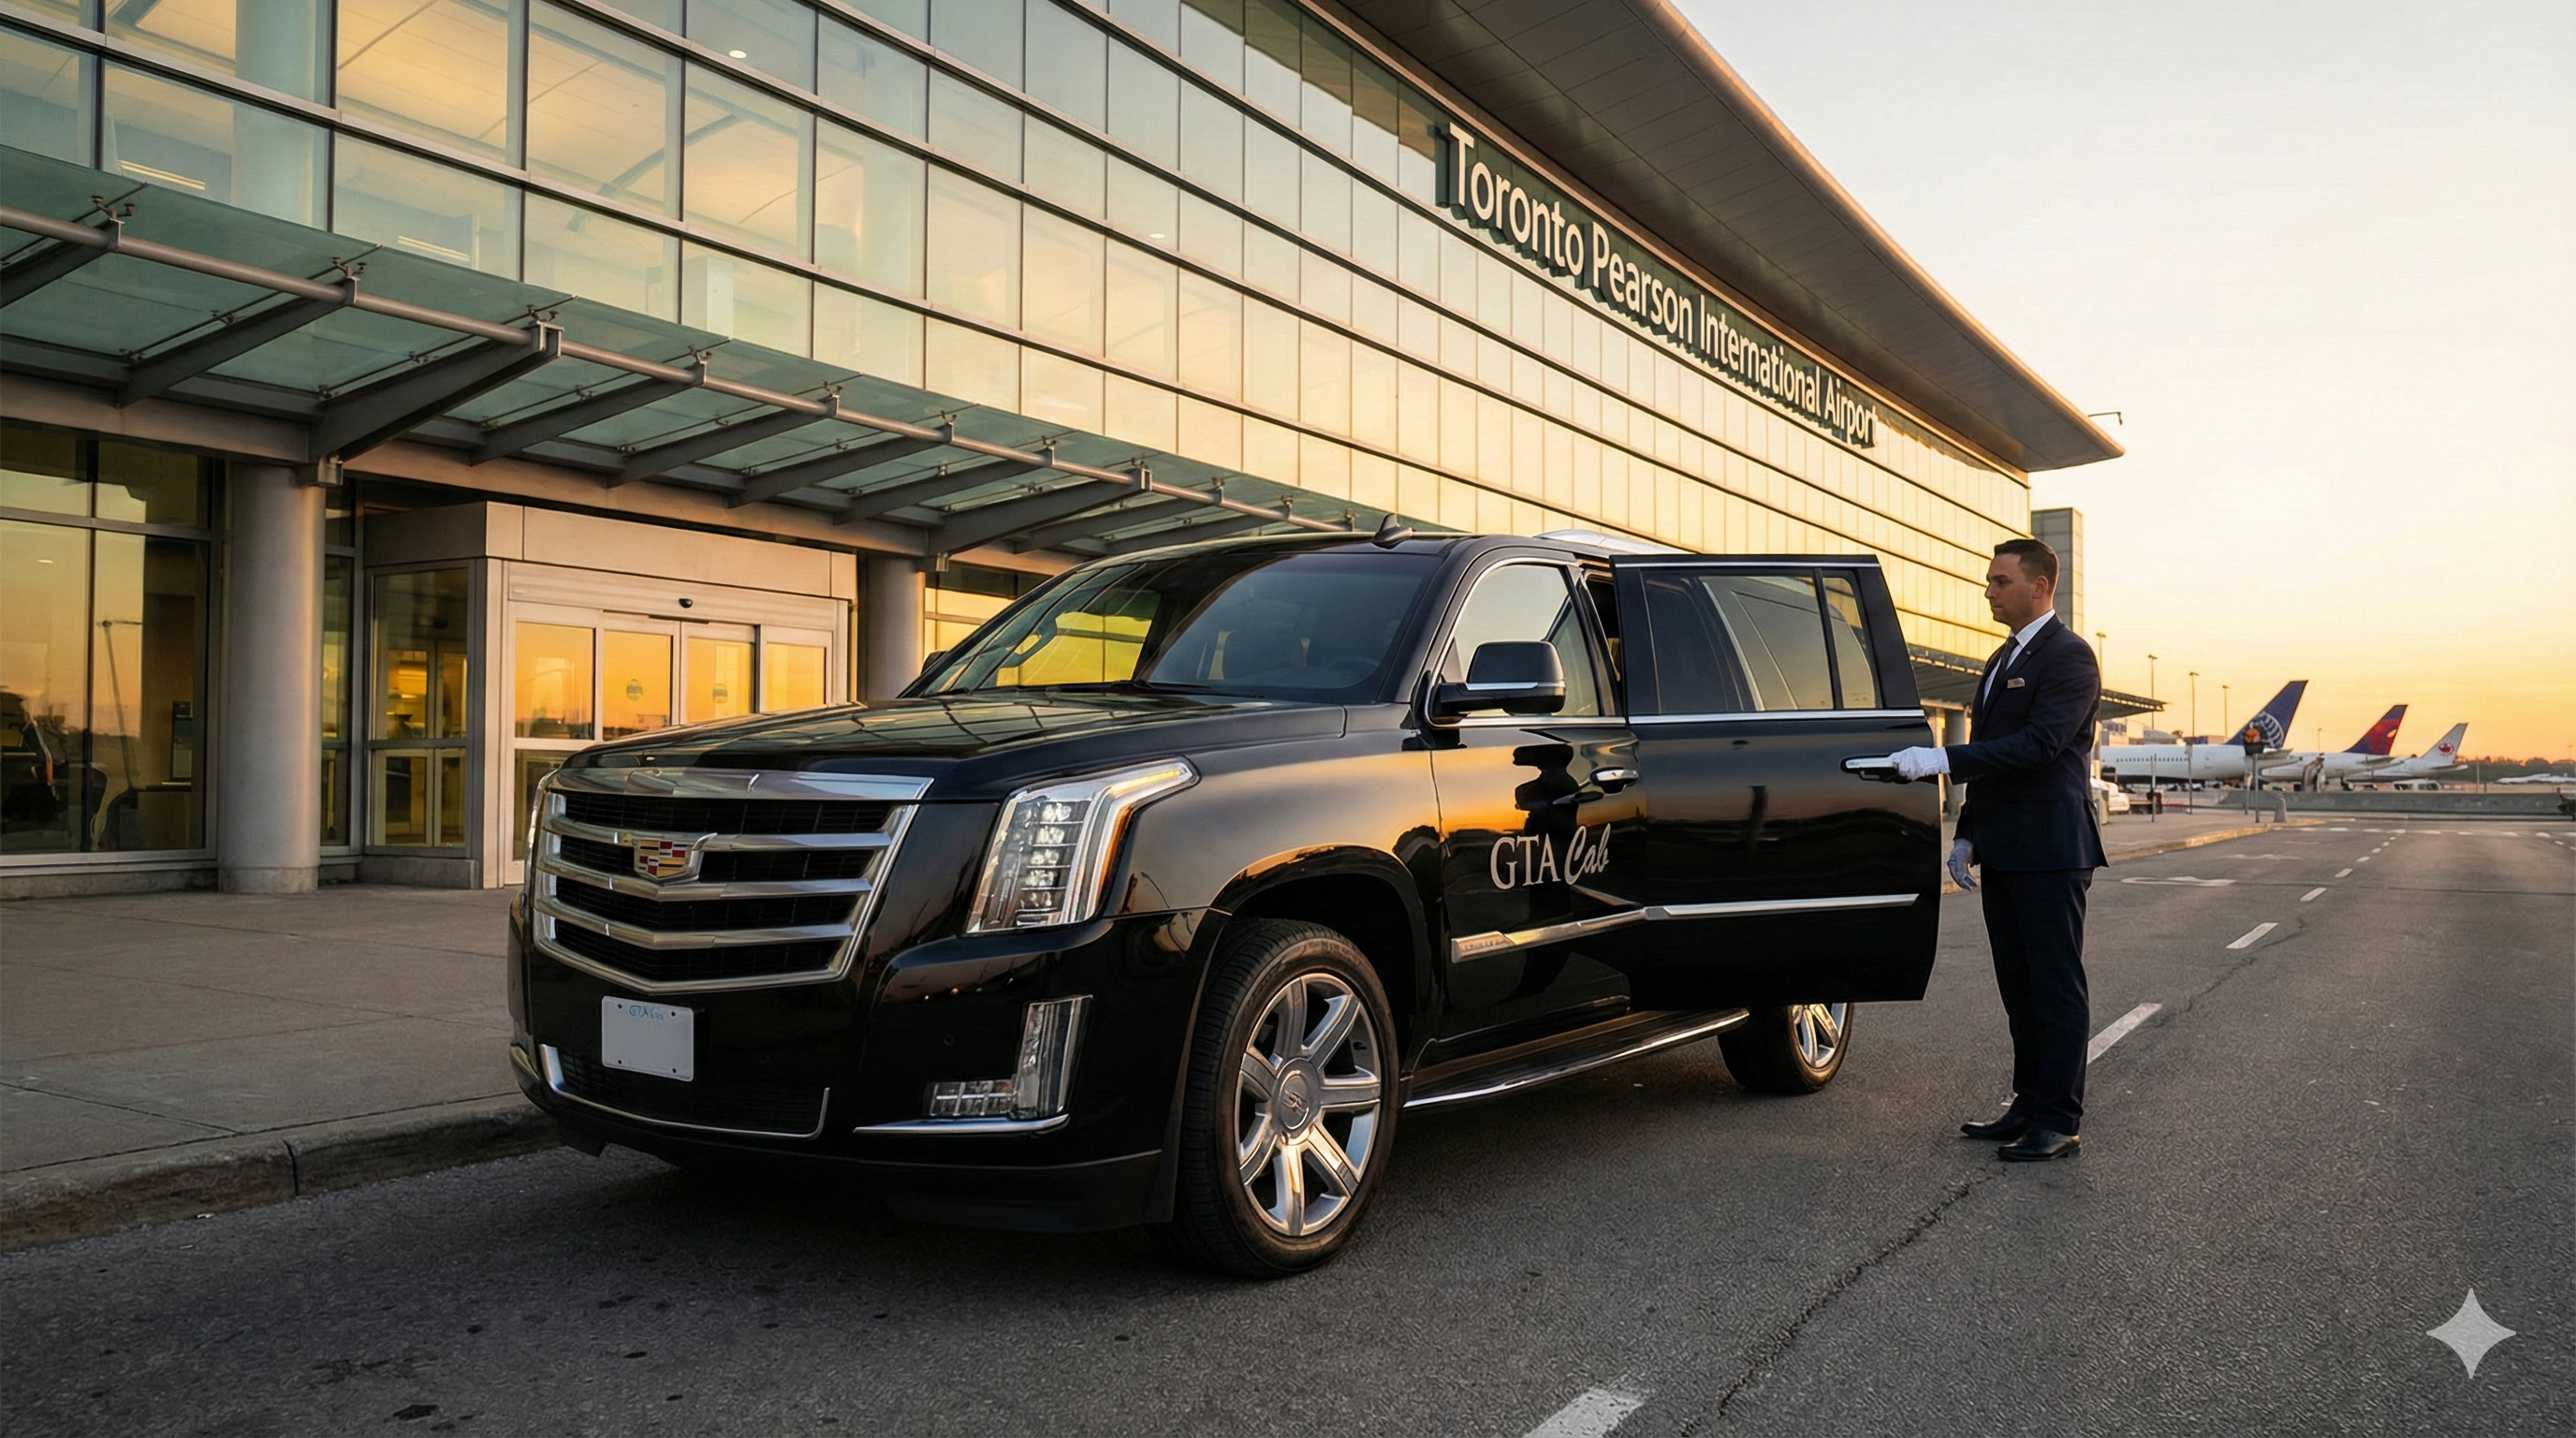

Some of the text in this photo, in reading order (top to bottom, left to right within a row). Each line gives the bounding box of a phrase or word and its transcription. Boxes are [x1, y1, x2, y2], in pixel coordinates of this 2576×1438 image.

[1449, 122, 1880, 446] Toronto Pearson International Airport
[1490, 823, 1611, 889] GTA Cab
